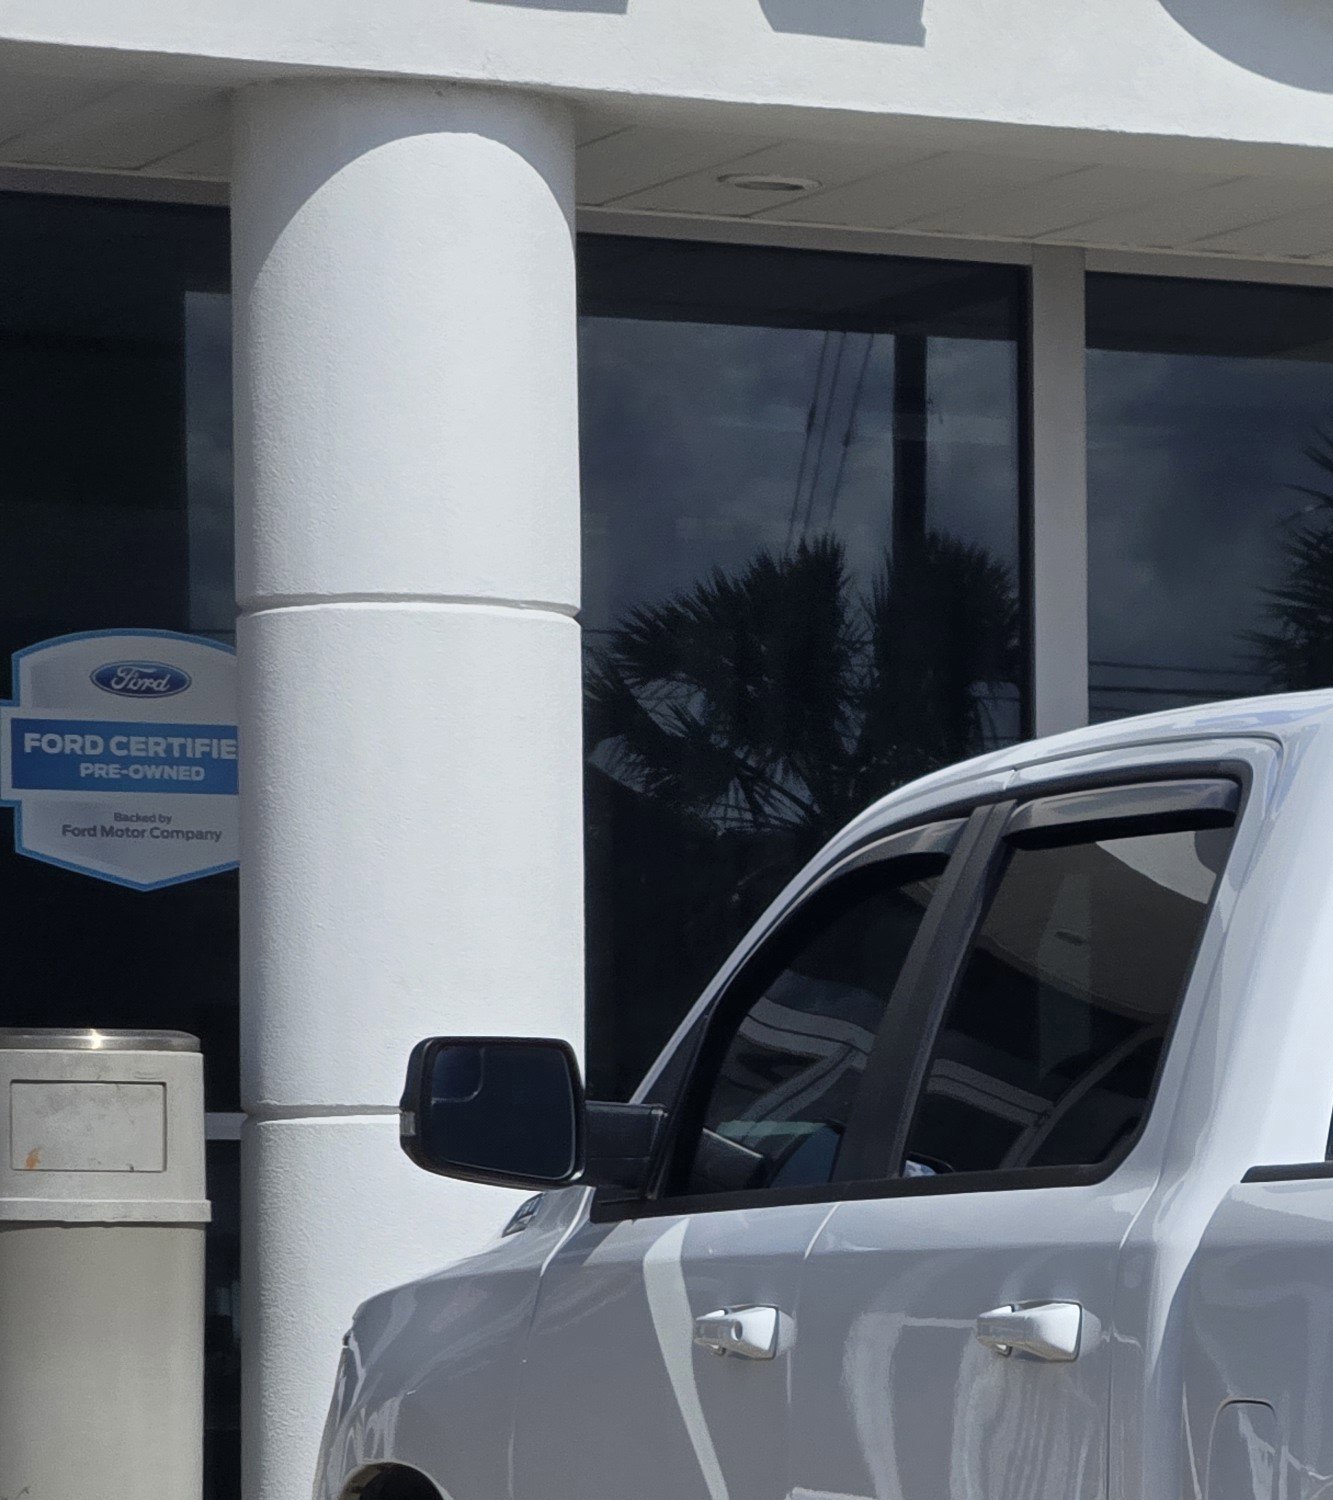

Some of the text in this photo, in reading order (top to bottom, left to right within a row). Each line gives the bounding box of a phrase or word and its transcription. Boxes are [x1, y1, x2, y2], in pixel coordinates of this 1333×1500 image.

[109, 665, 171, 692] Ford
[24, 733, 238, 760] FORD CERTIFIE
[79, 763, 205, 781] PRE-OWNED
[114, 812, 172, 825] Backed by
[61, 824, 222, 843] Ford Motor Company
